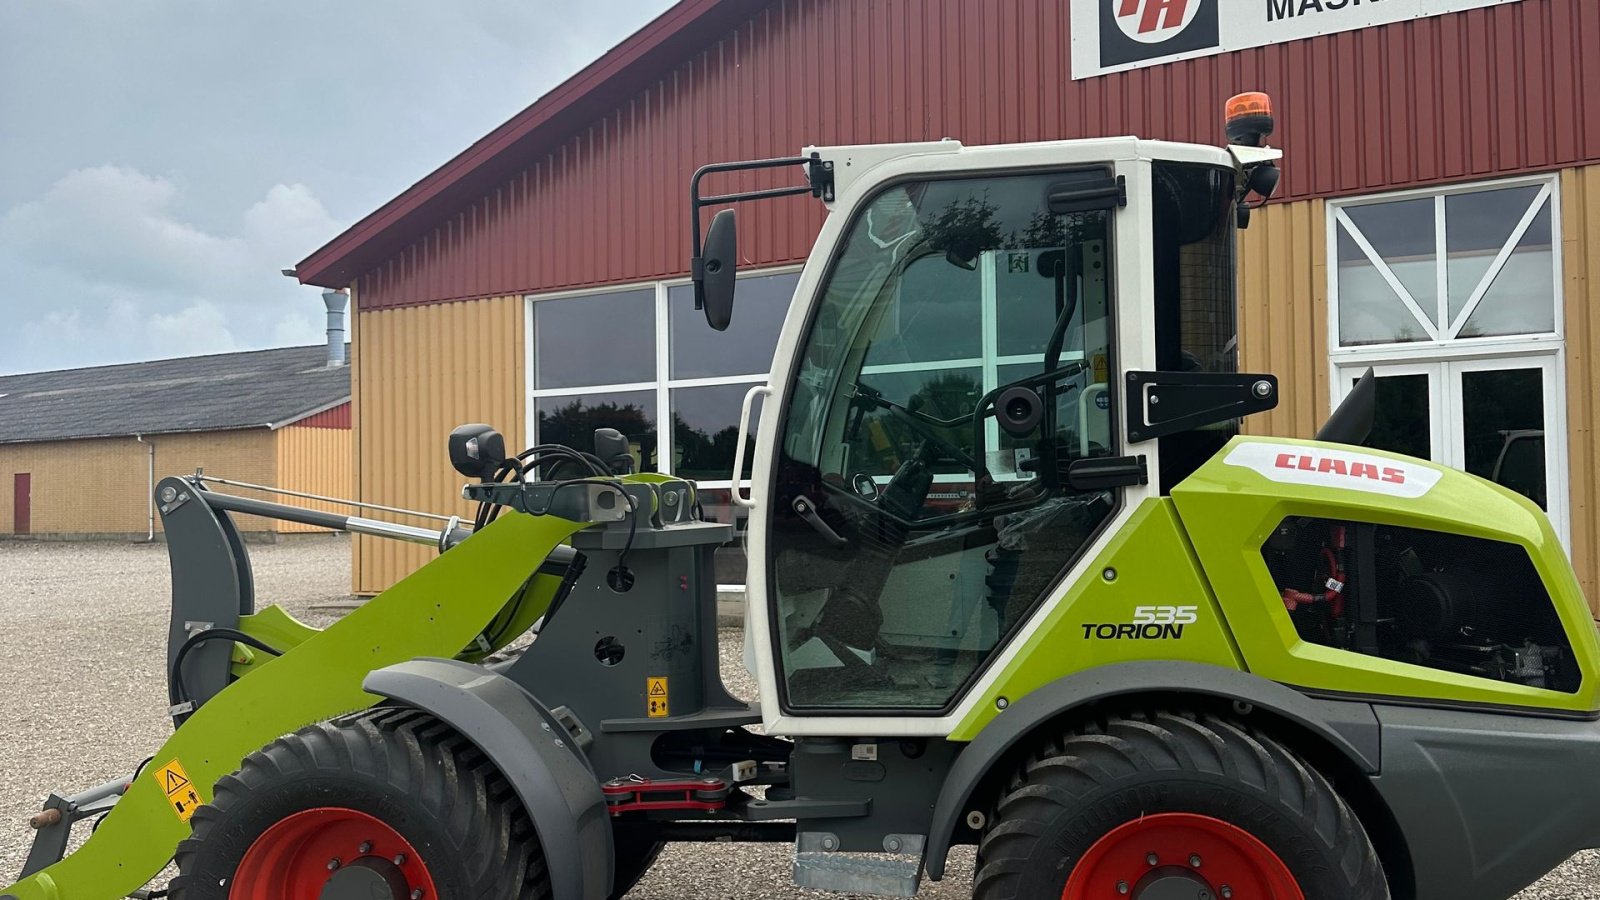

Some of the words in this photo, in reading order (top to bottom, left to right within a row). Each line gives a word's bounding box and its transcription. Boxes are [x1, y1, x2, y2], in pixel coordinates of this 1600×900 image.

[1275, 453, 1405, 484] CLAAS
[1133, 605, 1198, 625] 535
[1081, 623, 1184, 640] TORION
